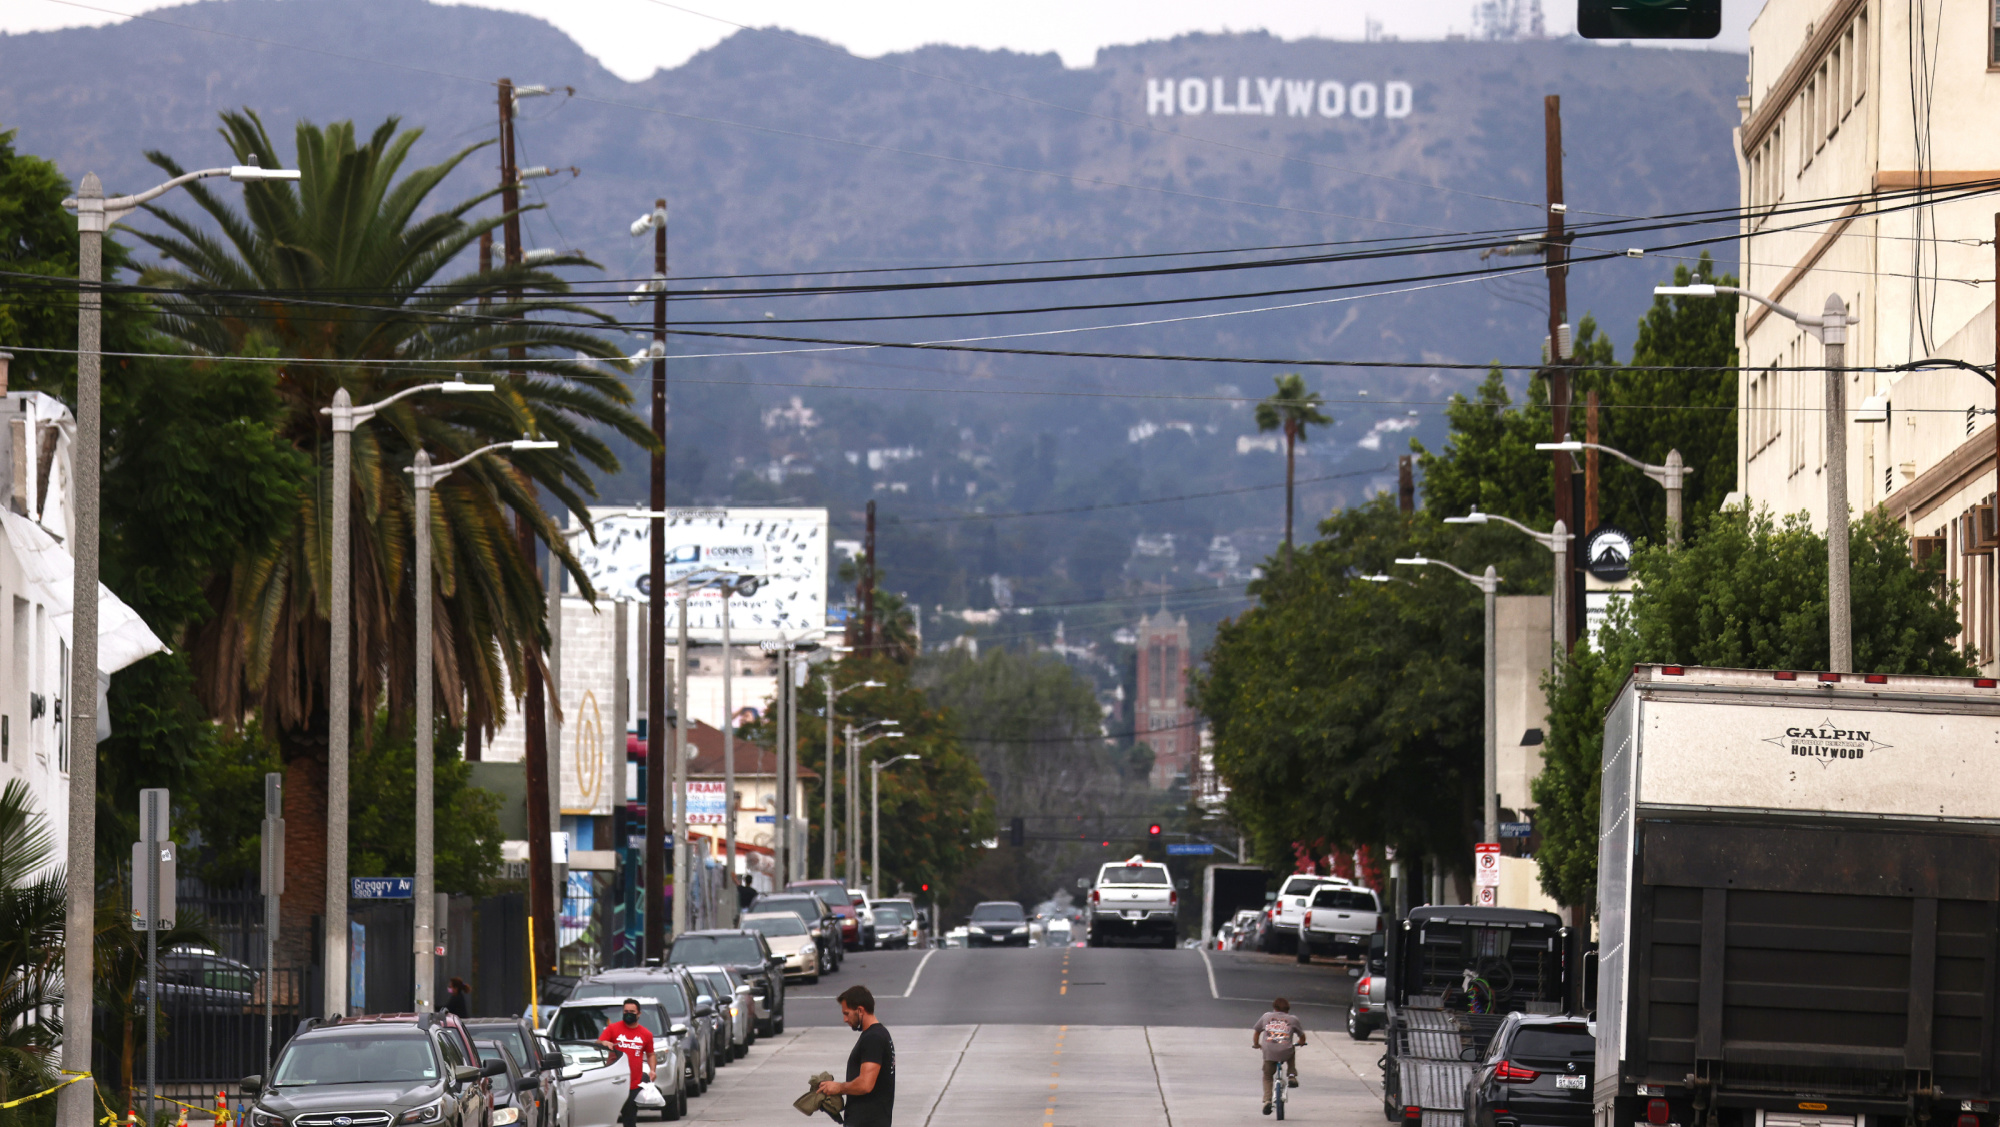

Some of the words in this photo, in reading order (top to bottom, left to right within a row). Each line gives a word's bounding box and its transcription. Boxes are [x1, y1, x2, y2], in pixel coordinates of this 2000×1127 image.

[1147, 76, 1413, 118] HOLLYWOOD
[674, 600, 712, 608] Sarch
[1786, 727, 1871, 741] GALPIN
[1791, 745, 1864, 759] HOLLYWOOD
[354, 879, 392, 892] Gregory
[399, 879, 410, 890] Av
